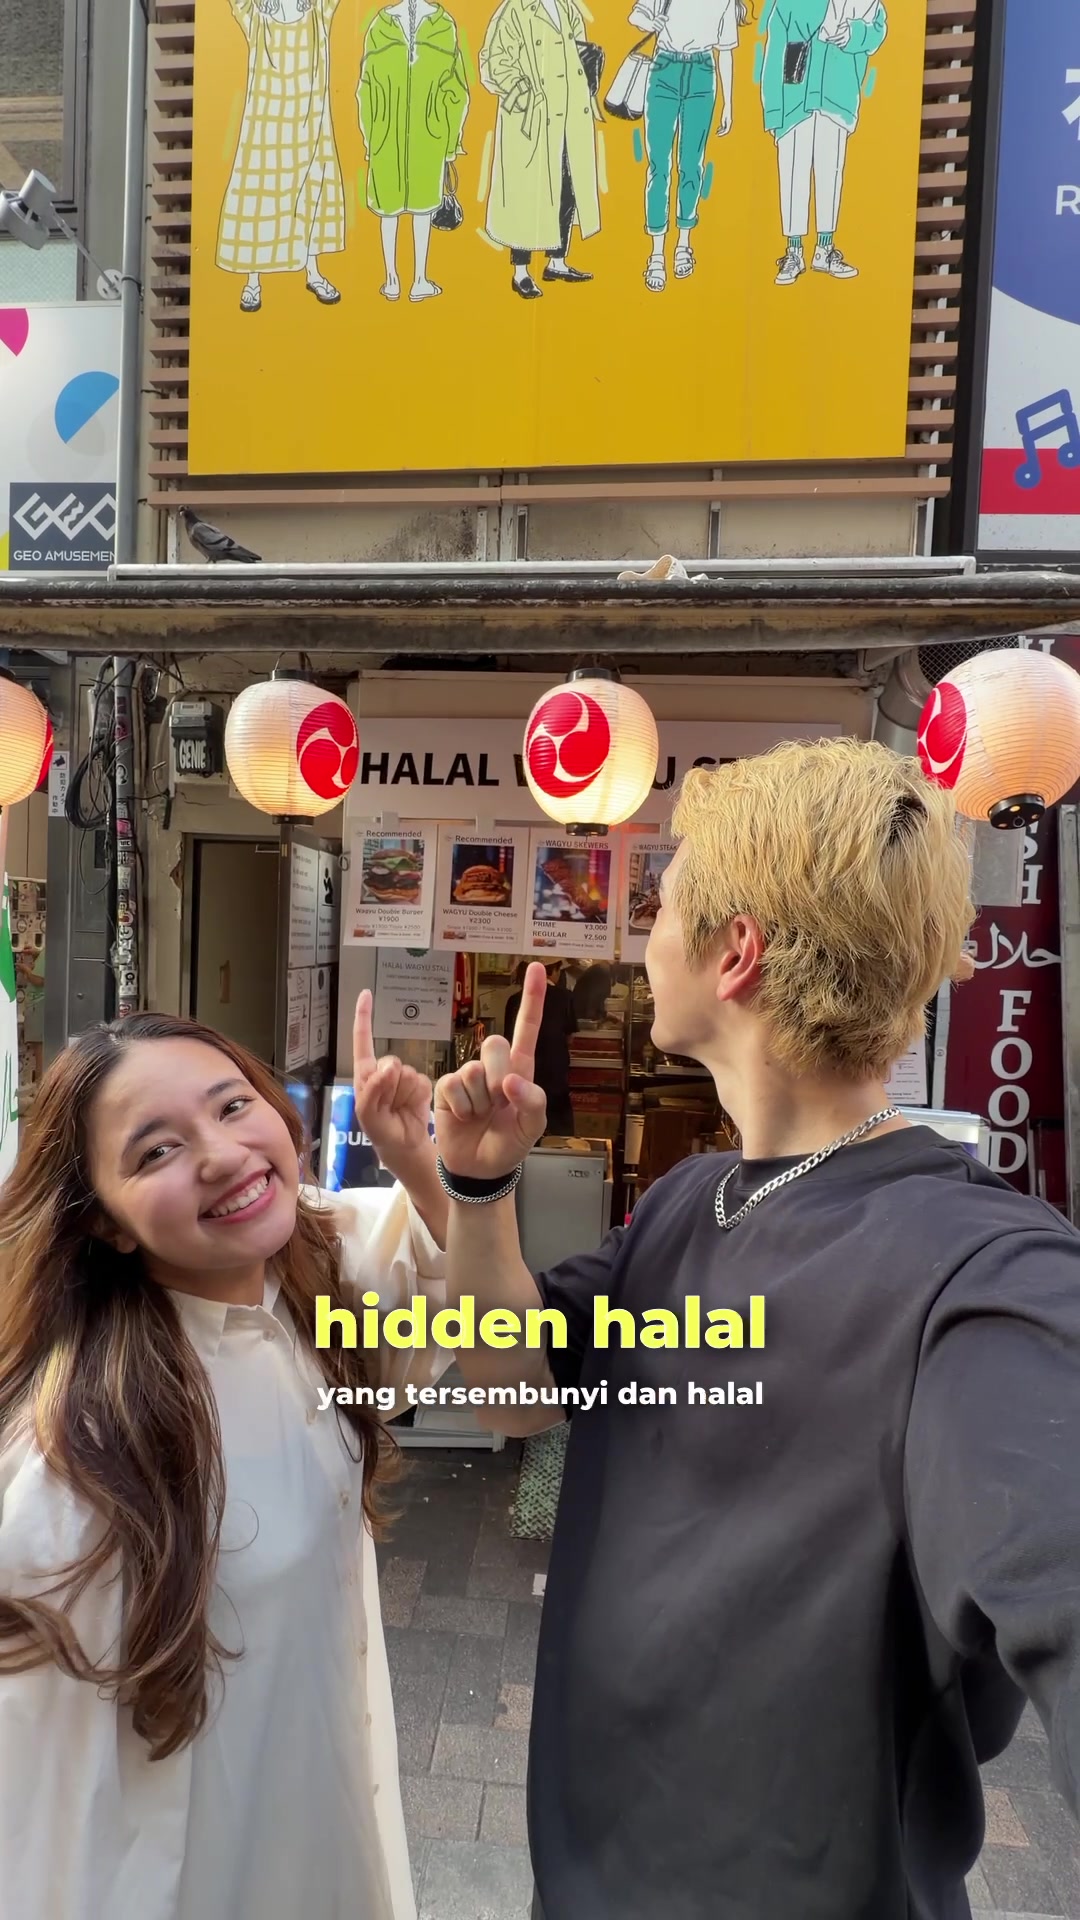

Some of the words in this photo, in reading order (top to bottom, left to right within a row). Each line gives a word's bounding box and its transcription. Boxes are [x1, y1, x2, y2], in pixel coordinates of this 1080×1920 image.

[13, 550, 42, 561] GEO
[361, 752, 499, 786] HALAL
[455, 835, 513, 844] Recommended
[545, 840, 572, 848] WAGYU
[573, 841, 609, 849] SKEWERS
[974, 922, 1062, 969] حلال
[405, 963, 430, 971] WAGYU
[988, 989, 1033, 1174] FOOD
